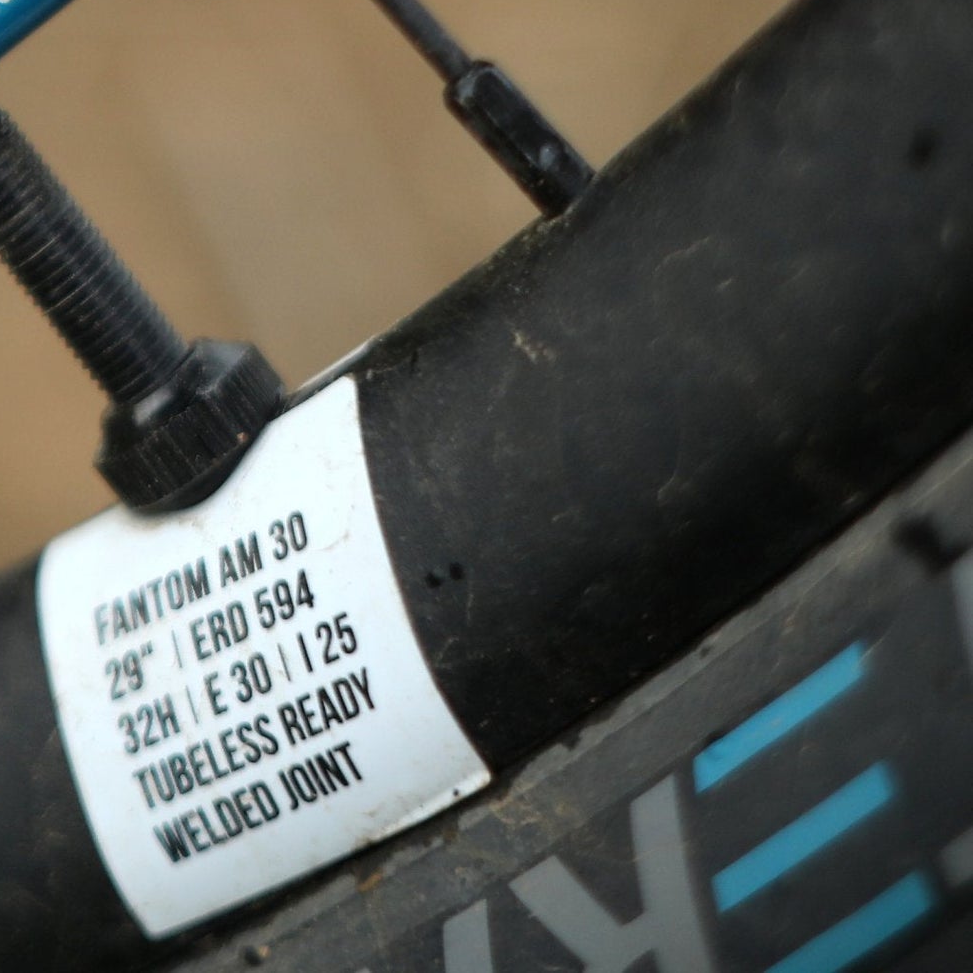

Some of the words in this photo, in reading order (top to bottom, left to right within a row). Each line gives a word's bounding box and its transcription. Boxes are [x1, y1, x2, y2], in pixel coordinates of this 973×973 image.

[94, 556, 212, 646] FANTOM
[218, 530, 265, 589] AM
[268, 510, 309, 563] 30
[189, 600, 250, 663] ERD
[253, 568, 316, 632] 594
[117, 693, 182, 757] 32H
[203, 671, 230, 718] E
[229, 651, 274, 705] 30
[314, 611, 359, 666] 25
[132, 712, 281, 810] TUBELESS
[276, 666, 376, 748] READY
[153, 779, 282, 865] WELDED
[277, 740, 364, 812] JOINT
